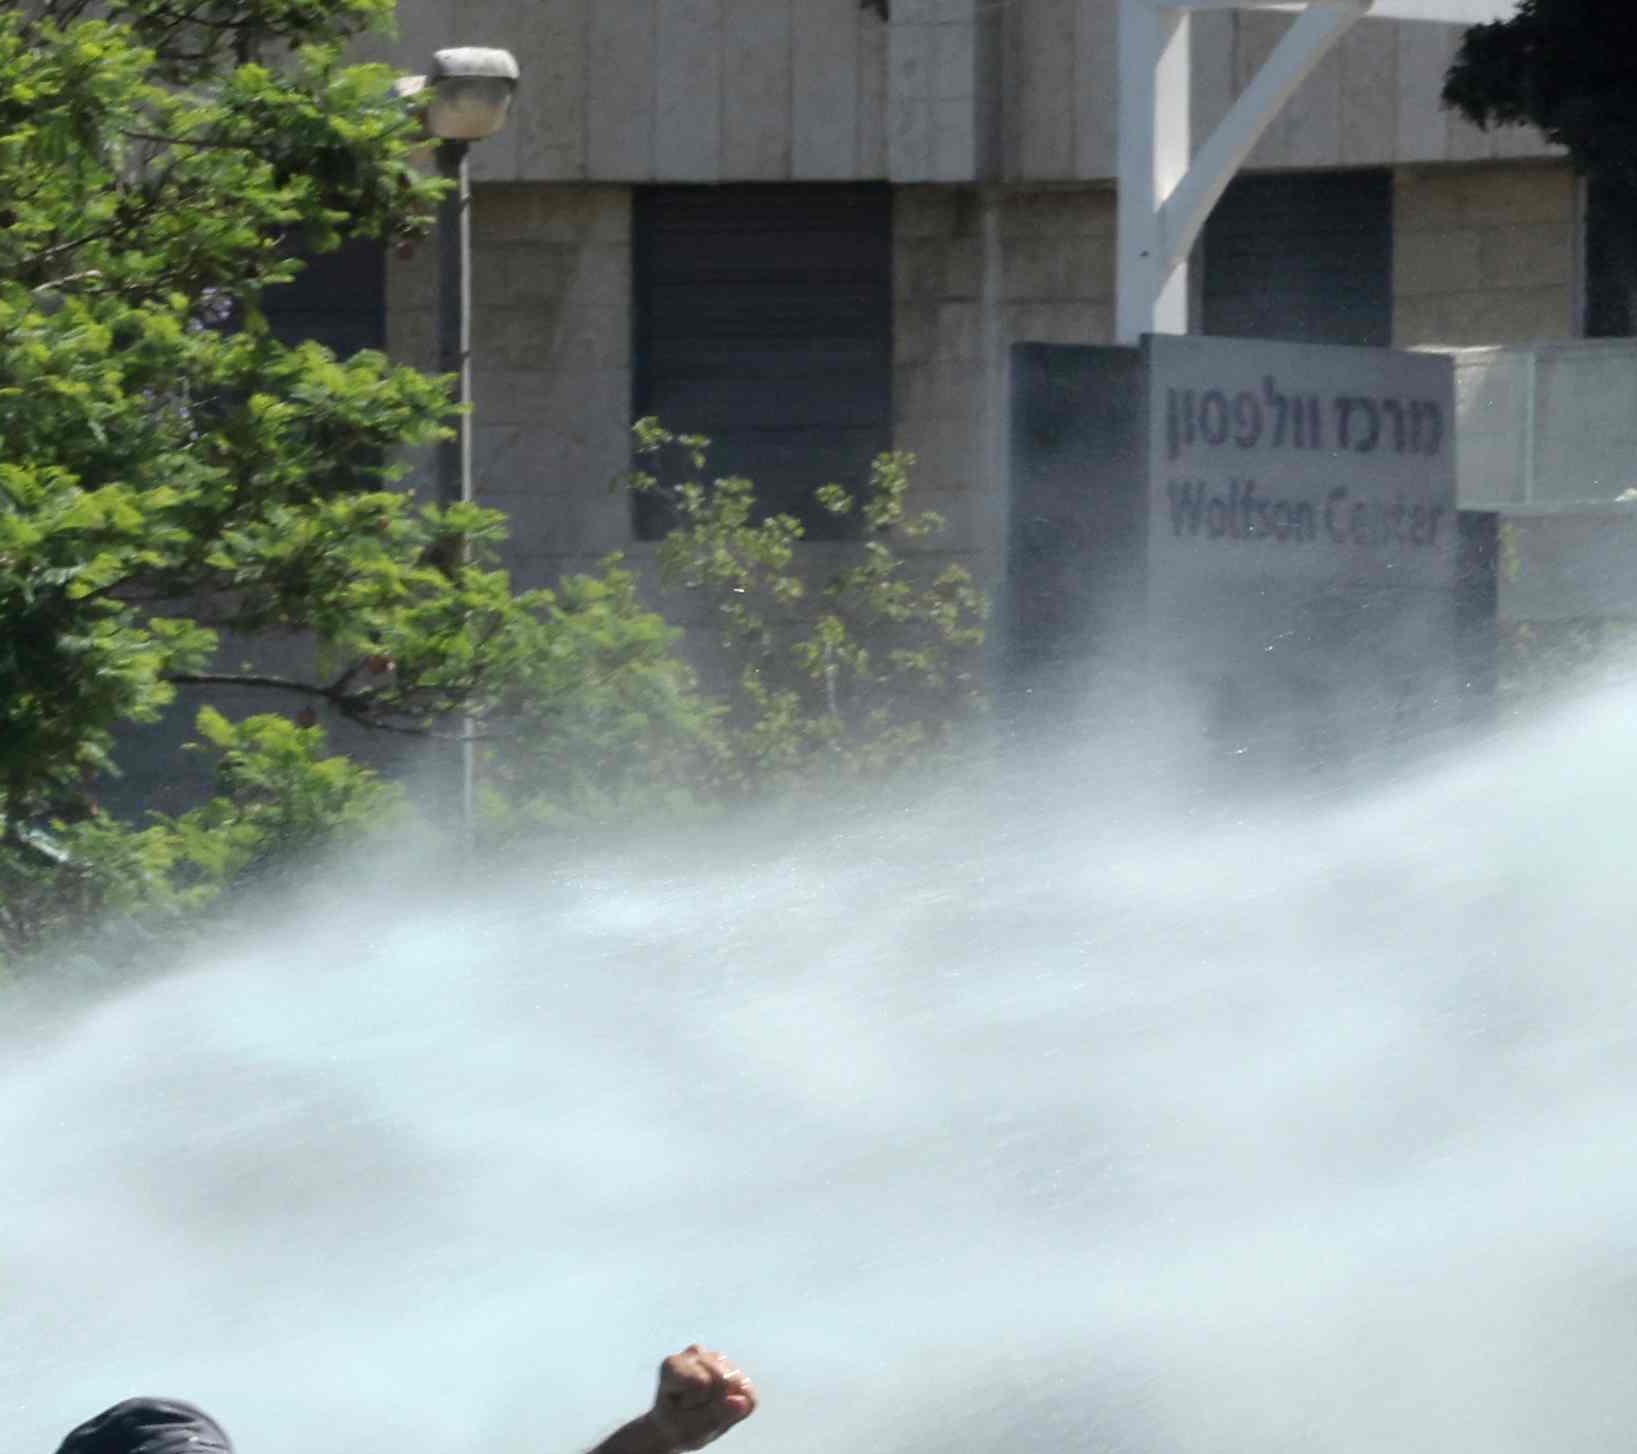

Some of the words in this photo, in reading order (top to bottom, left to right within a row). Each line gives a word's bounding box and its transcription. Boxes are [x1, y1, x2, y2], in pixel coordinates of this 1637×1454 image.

[1166, 374, 1321, 460] וולפסון
[1332, 396, 1444, 455] מרכז
[1167, 479, 1316, 541] Wolfson
